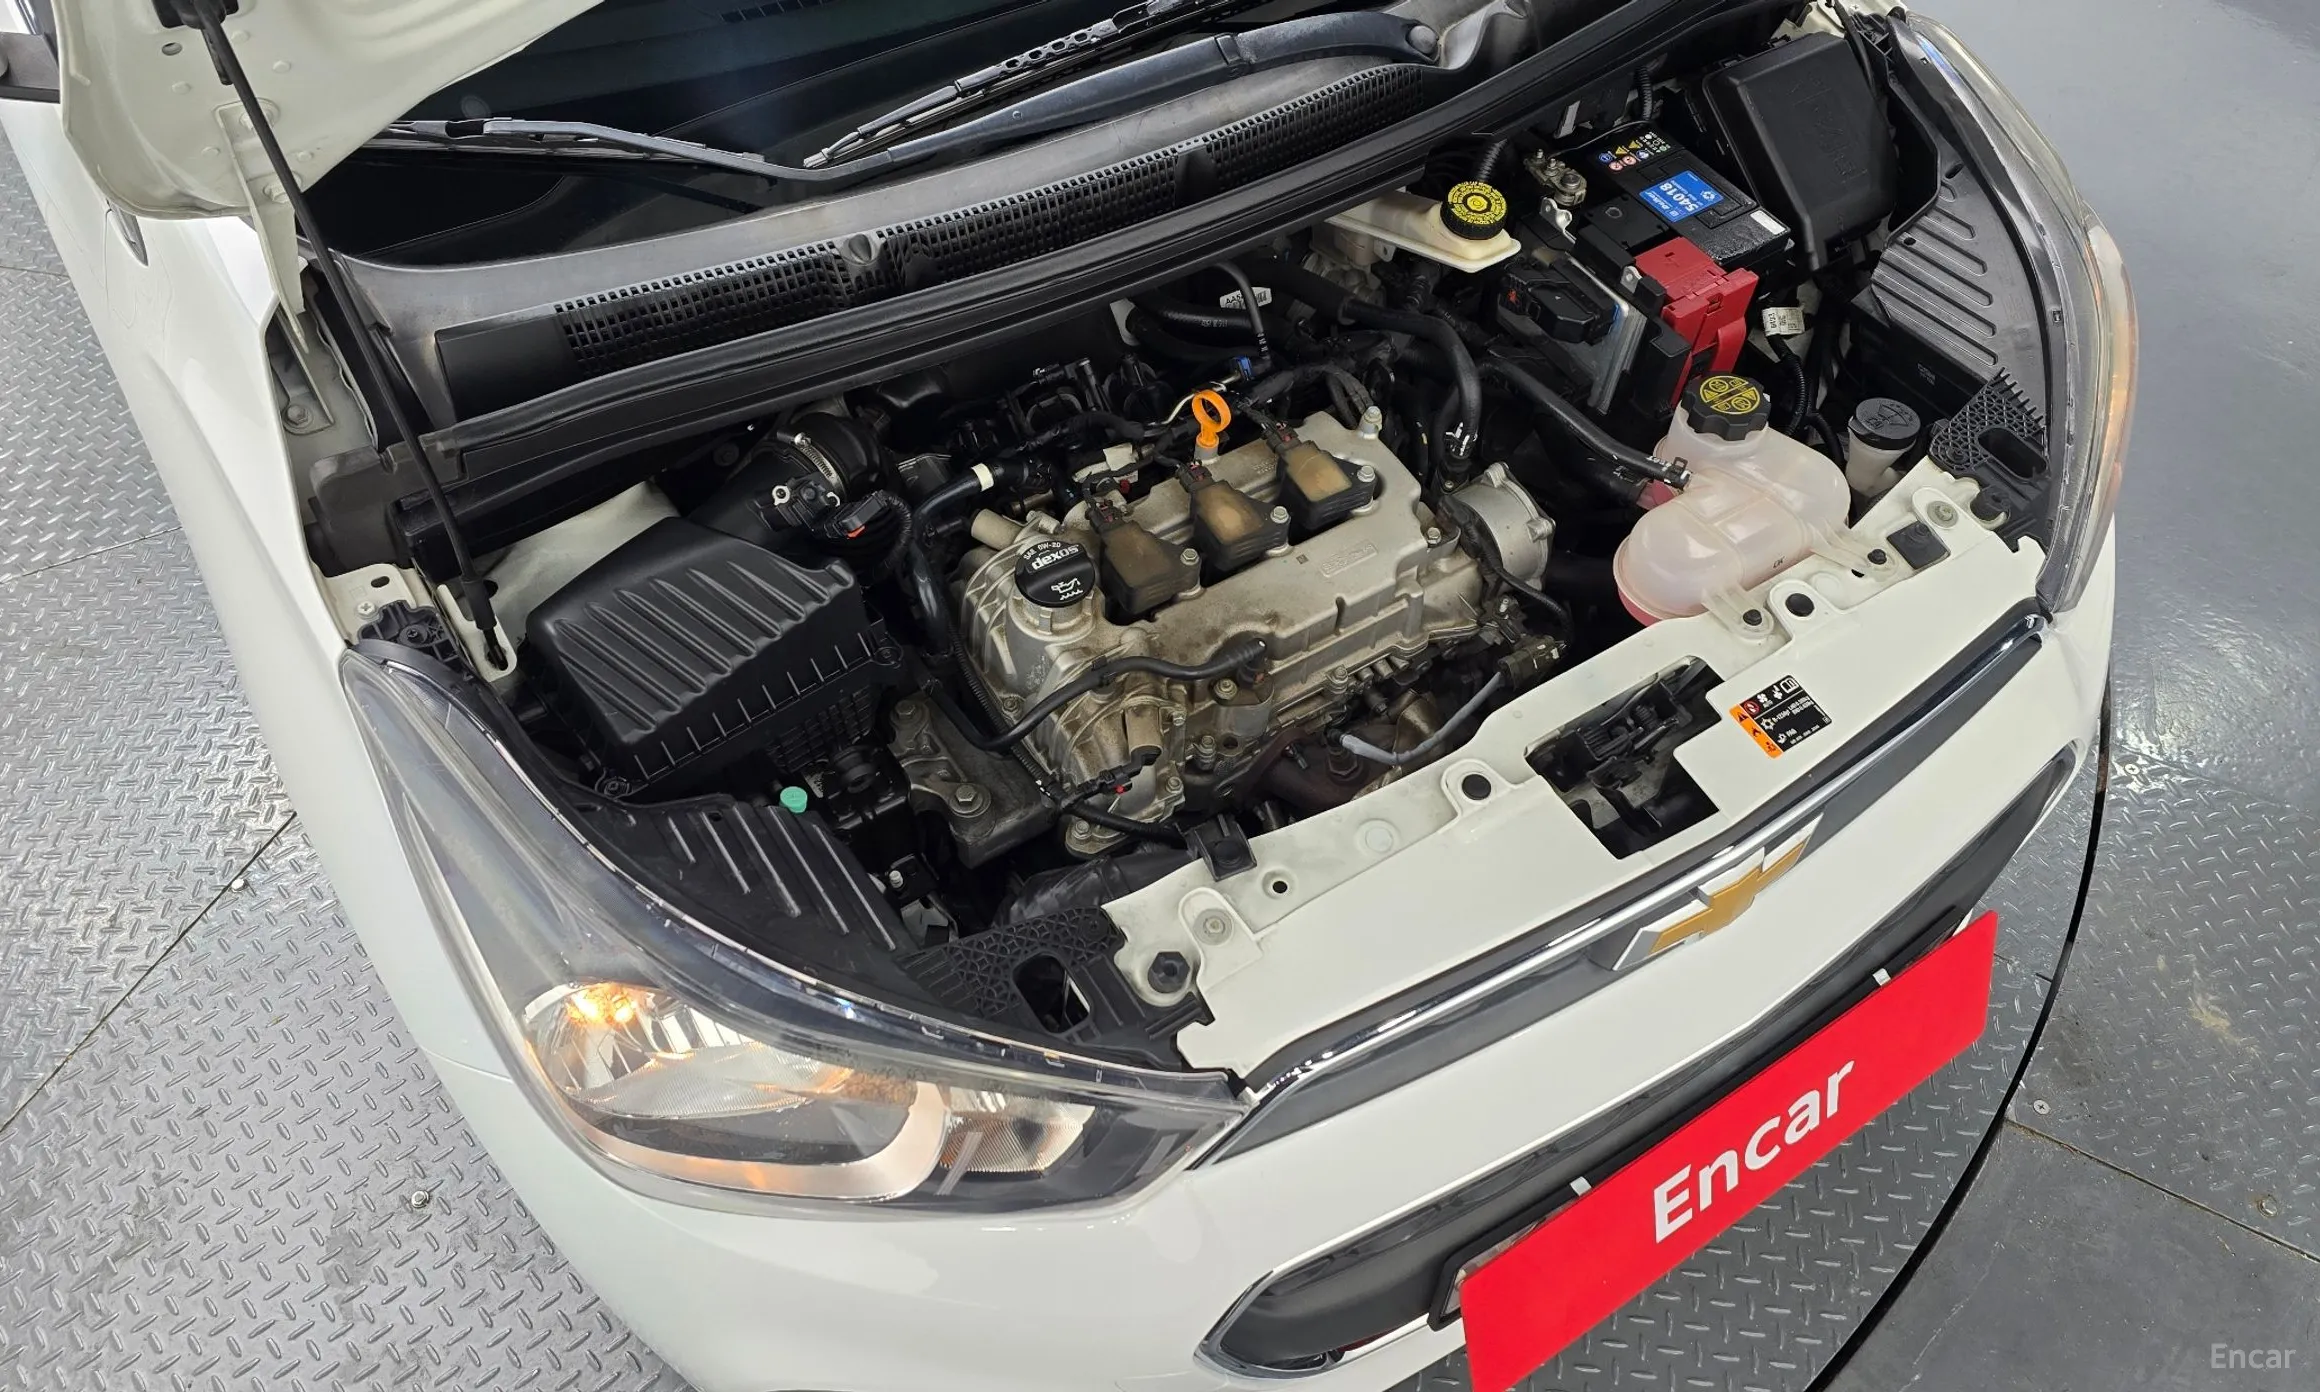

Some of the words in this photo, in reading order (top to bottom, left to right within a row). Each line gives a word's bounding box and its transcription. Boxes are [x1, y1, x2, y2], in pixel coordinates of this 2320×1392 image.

[1660, 182, 1699, 212] 54018
[1023, 549, 1036, 560] SAE
[1038, 542, 1061, 551] 0W-20
[1032, 544, 1079, 570] dexos
[1653, 1060, 1855, 1244] Encar
